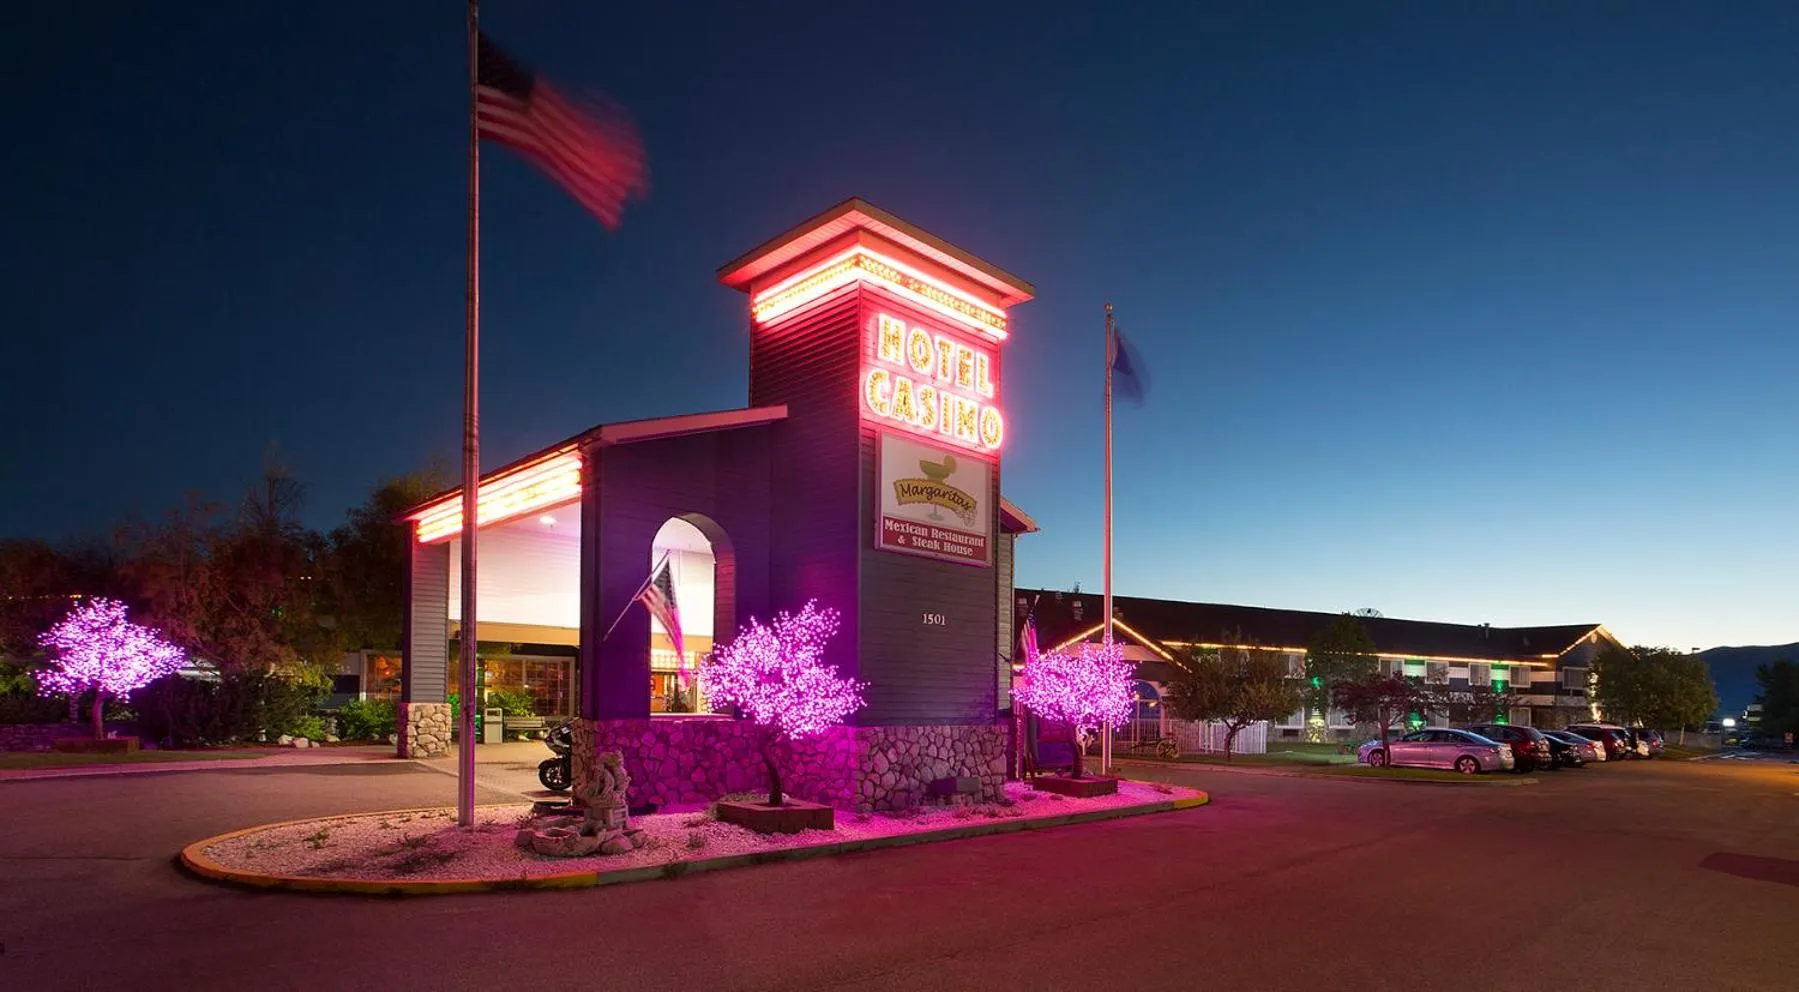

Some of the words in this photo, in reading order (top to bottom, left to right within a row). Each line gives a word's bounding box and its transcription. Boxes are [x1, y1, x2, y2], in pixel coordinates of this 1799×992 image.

[877, 313, 994, 398] HOTEL
[865, 368, 1003, 450] CASINO
[899, 483, 972, 511] Margaritas
[884, 519, 928, 537] Mexican
[931, 528, 985, 547] Restaurant
[897, 536, 905, 545] &
[912, 535, 940, 550] Steak
[943, 541, 974, 557] House
[922, 613, 946, 626] 1501
